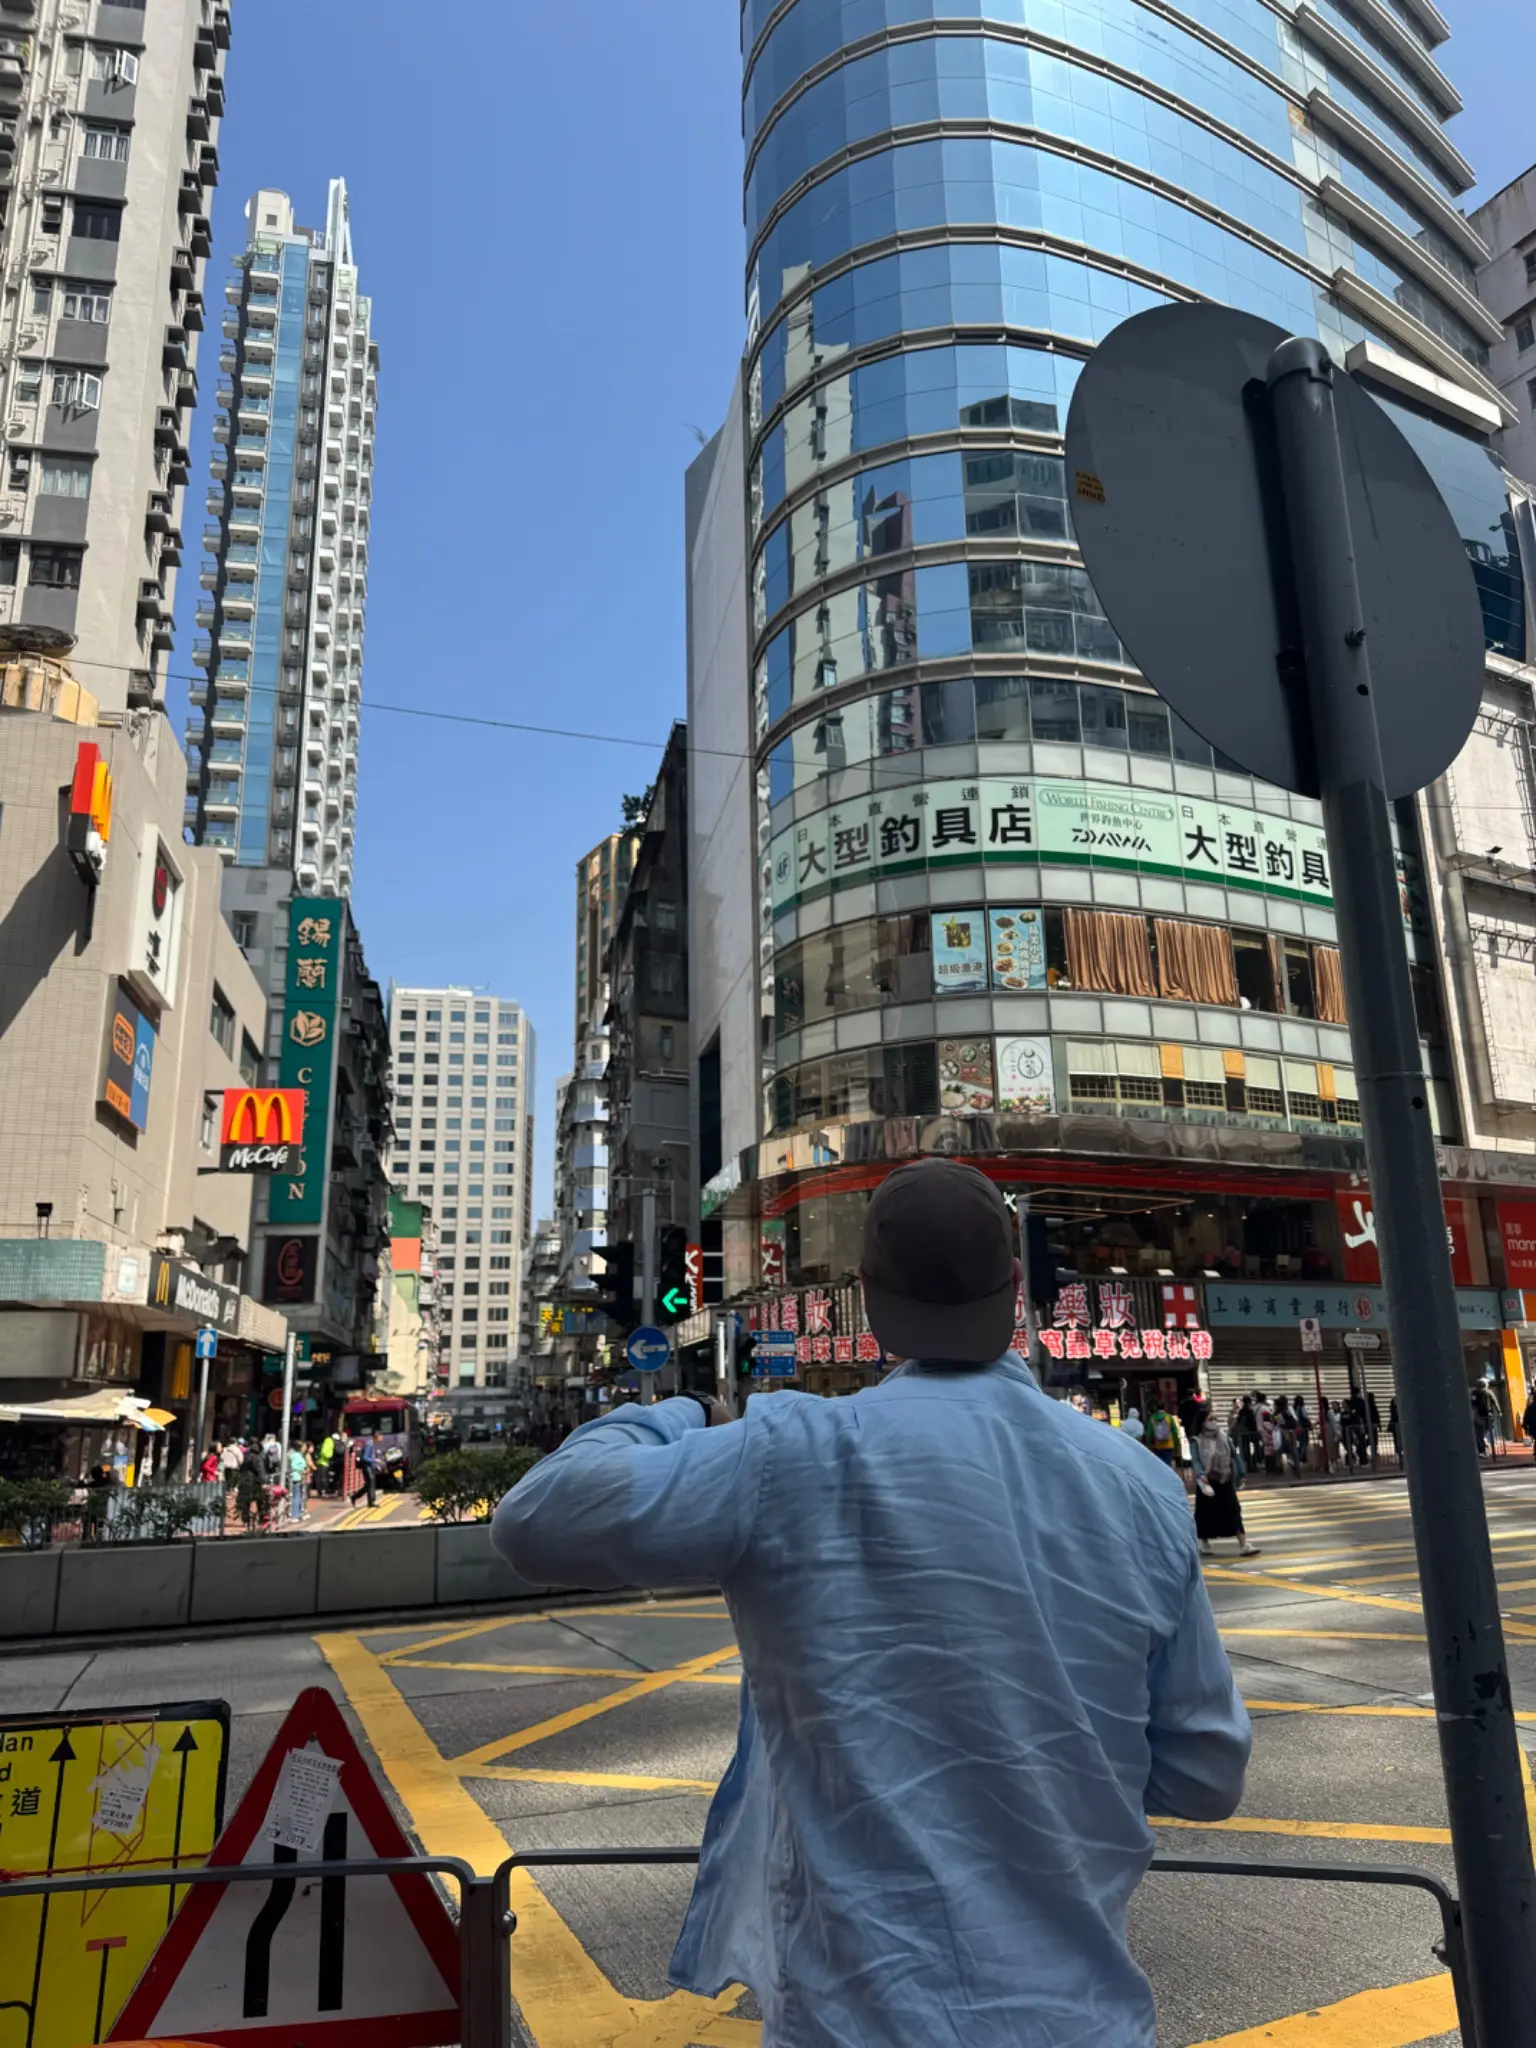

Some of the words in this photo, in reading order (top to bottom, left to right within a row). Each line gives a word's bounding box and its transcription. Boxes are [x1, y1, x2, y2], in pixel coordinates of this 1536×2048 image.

[798, 804, 1032, 884] 大型釣具店
[1071, 828, 1152, 852] DAIWA
[1080, 812, 1143, 830] 世界釣魚中心
[1184, 825, 1330, 889] 大型釣具
[296, 917, 331, 989] 錫蘭
[1053, 1282, 1135, 1329] 藥妝
